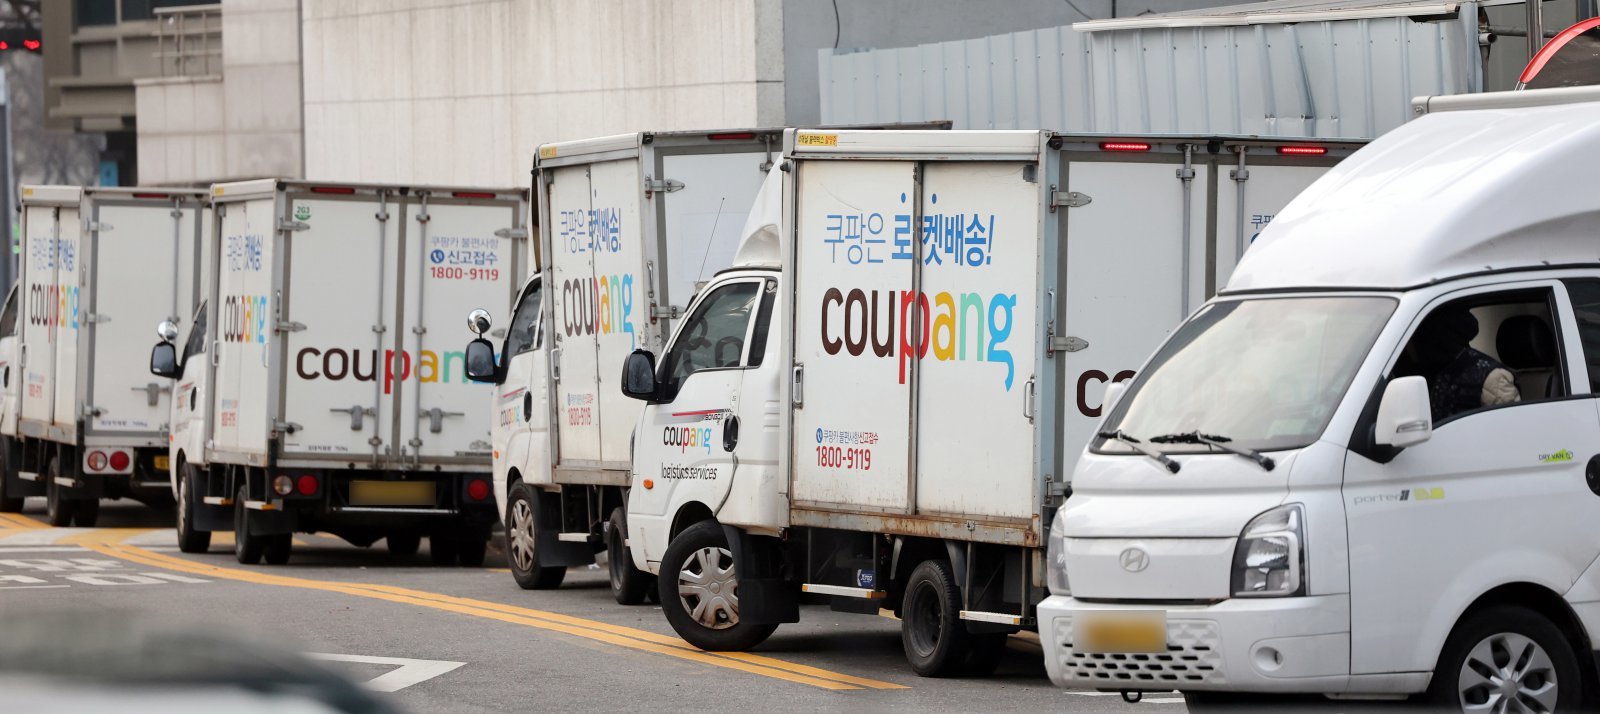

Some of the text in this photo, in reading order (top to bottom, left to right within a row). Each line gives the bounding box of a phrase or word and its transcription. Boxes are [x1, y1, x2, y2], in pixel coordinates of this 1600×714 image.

[560, 209, 586, 254] 쿠팡은
[824, 213, 995, 267] 쿠팡은 로켓배송!
[448, 250, 499, 266] 신고접수
[430, 266, 499, 281] 1800-9119
[821, 287, 1017, 393] coupang
[296, 347, 500, 394] coupan
[663, 426, 712, 455] coupang
[661, 462, 718, 483] logistics services
[816, 445, 871, 471] 1800-9119
